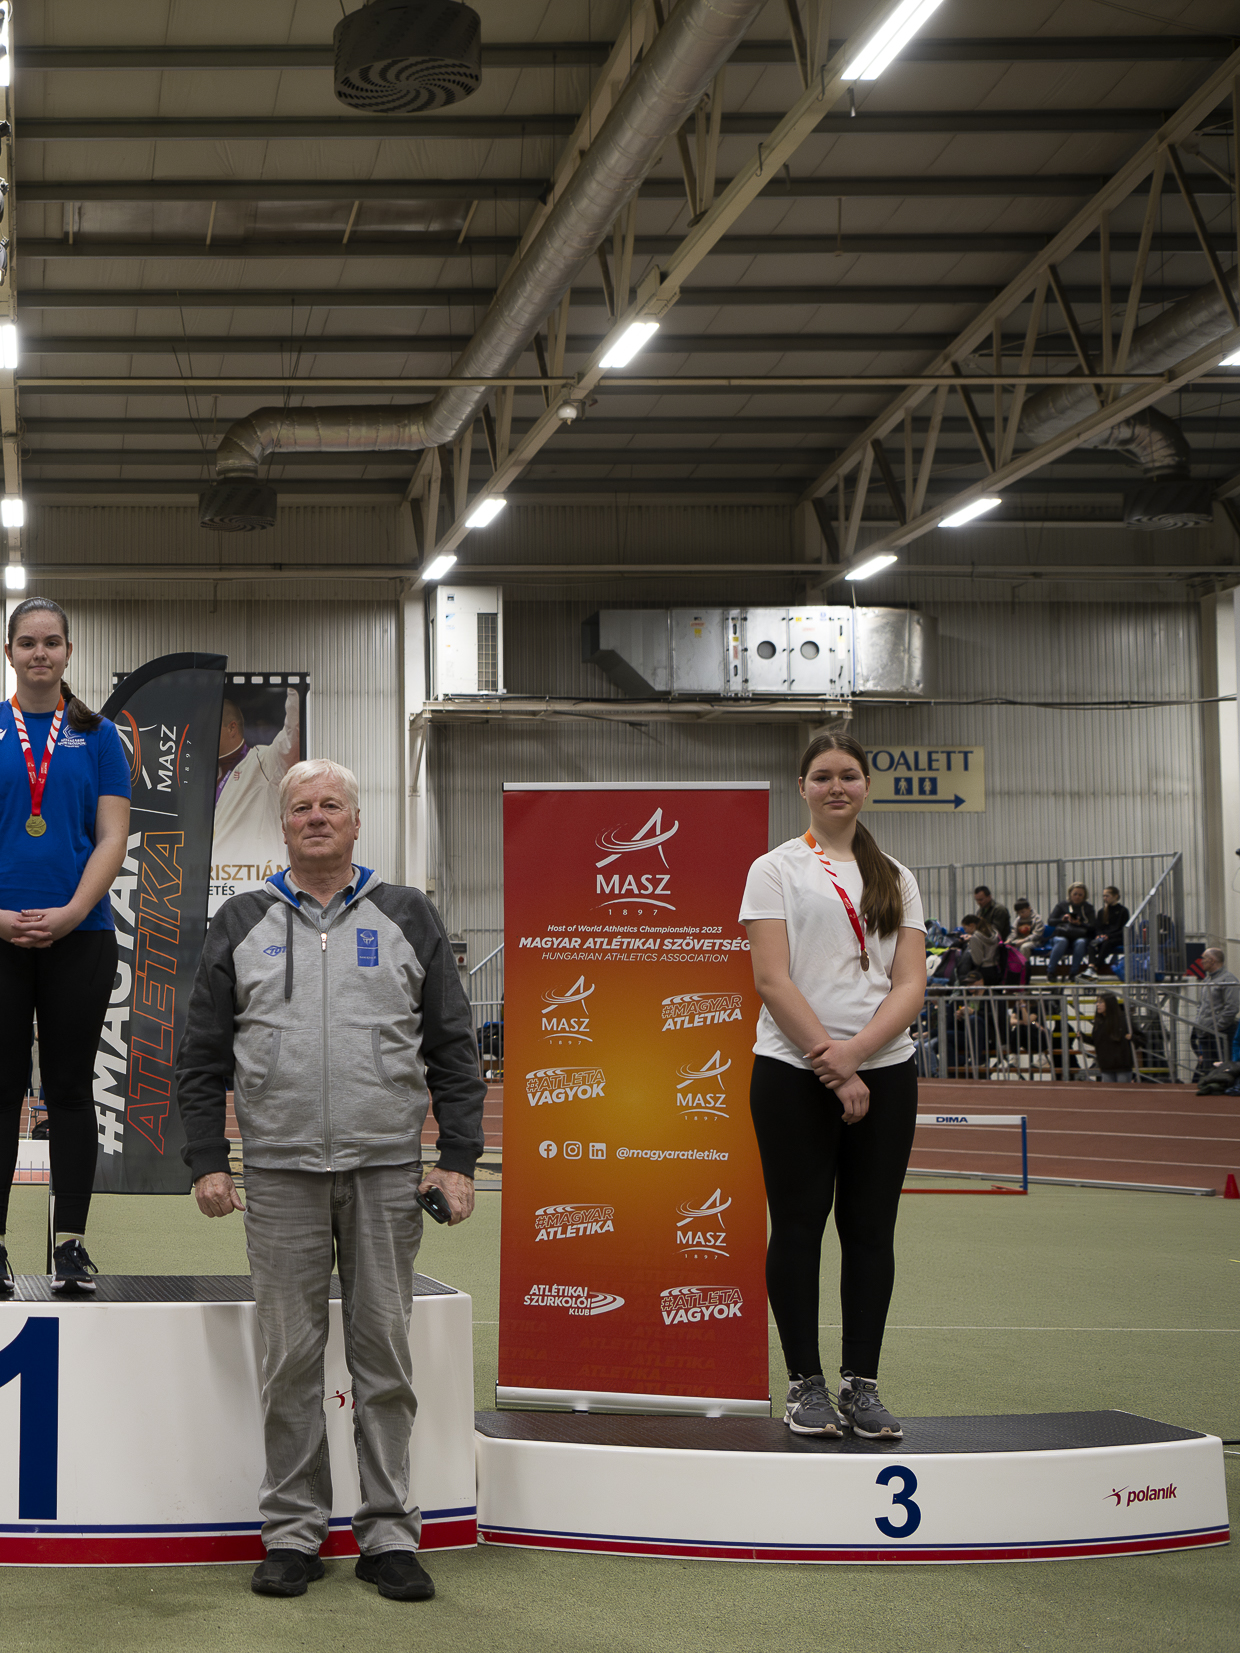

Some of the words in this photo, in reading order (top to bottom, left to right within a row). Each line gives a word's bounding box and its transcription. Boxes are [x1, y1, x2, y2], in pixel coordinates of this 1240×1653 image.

[157, 724, 177, 792] MASZ
[865, 750, 974, 772] TOALETT
[596, 874, 671, 894] MASZ
[608, 908, 658, 916] 1897
[547, 924, 566, 933] Host
[567, 924, 577, 933] of
[578, 924, 602, 933] World
[603, 925, 638, 933] Athletics
[639, 925, 700, 935] Championships
[519, 937, 581, 949] MAGYAR
[586, 935, 660, 950] ATLÉTIKAI
[662, 936, 751, 951] SZÖVETSÉG
[541, 952, 602, 961] HUNGARIAN
[604, 952, 658, 962] ATHLETICS
[659, 953, 729, 962] ASSOCIATION
[127, 831, 185, 1155] ATLETIKA
[661, 994, 743, 1020] #MAGYAR
[541, 1017, 590, 1032] MASZ
[527, 1082, 606, 1107] VAGYOK
[676, 1092, 726, 1108] MASZ
[616, 1147, 729, 1161] @magyaratletika
[535, 1206, 615, 1229] #MAGYAR
[676, 1230, 726, 1246] MASZ
[529, 1284, 588, 1297] ATLÉTIKAI
[523, 1295, 591, 1308] SZURKOLÓI
[568, 1308, 590, 1316] KLUB
[662, 1302, 743, 1325] VAGYOK
[874, 1464, 921, 1539] 3
[1126, 1483, 1177, 1507] polanik
